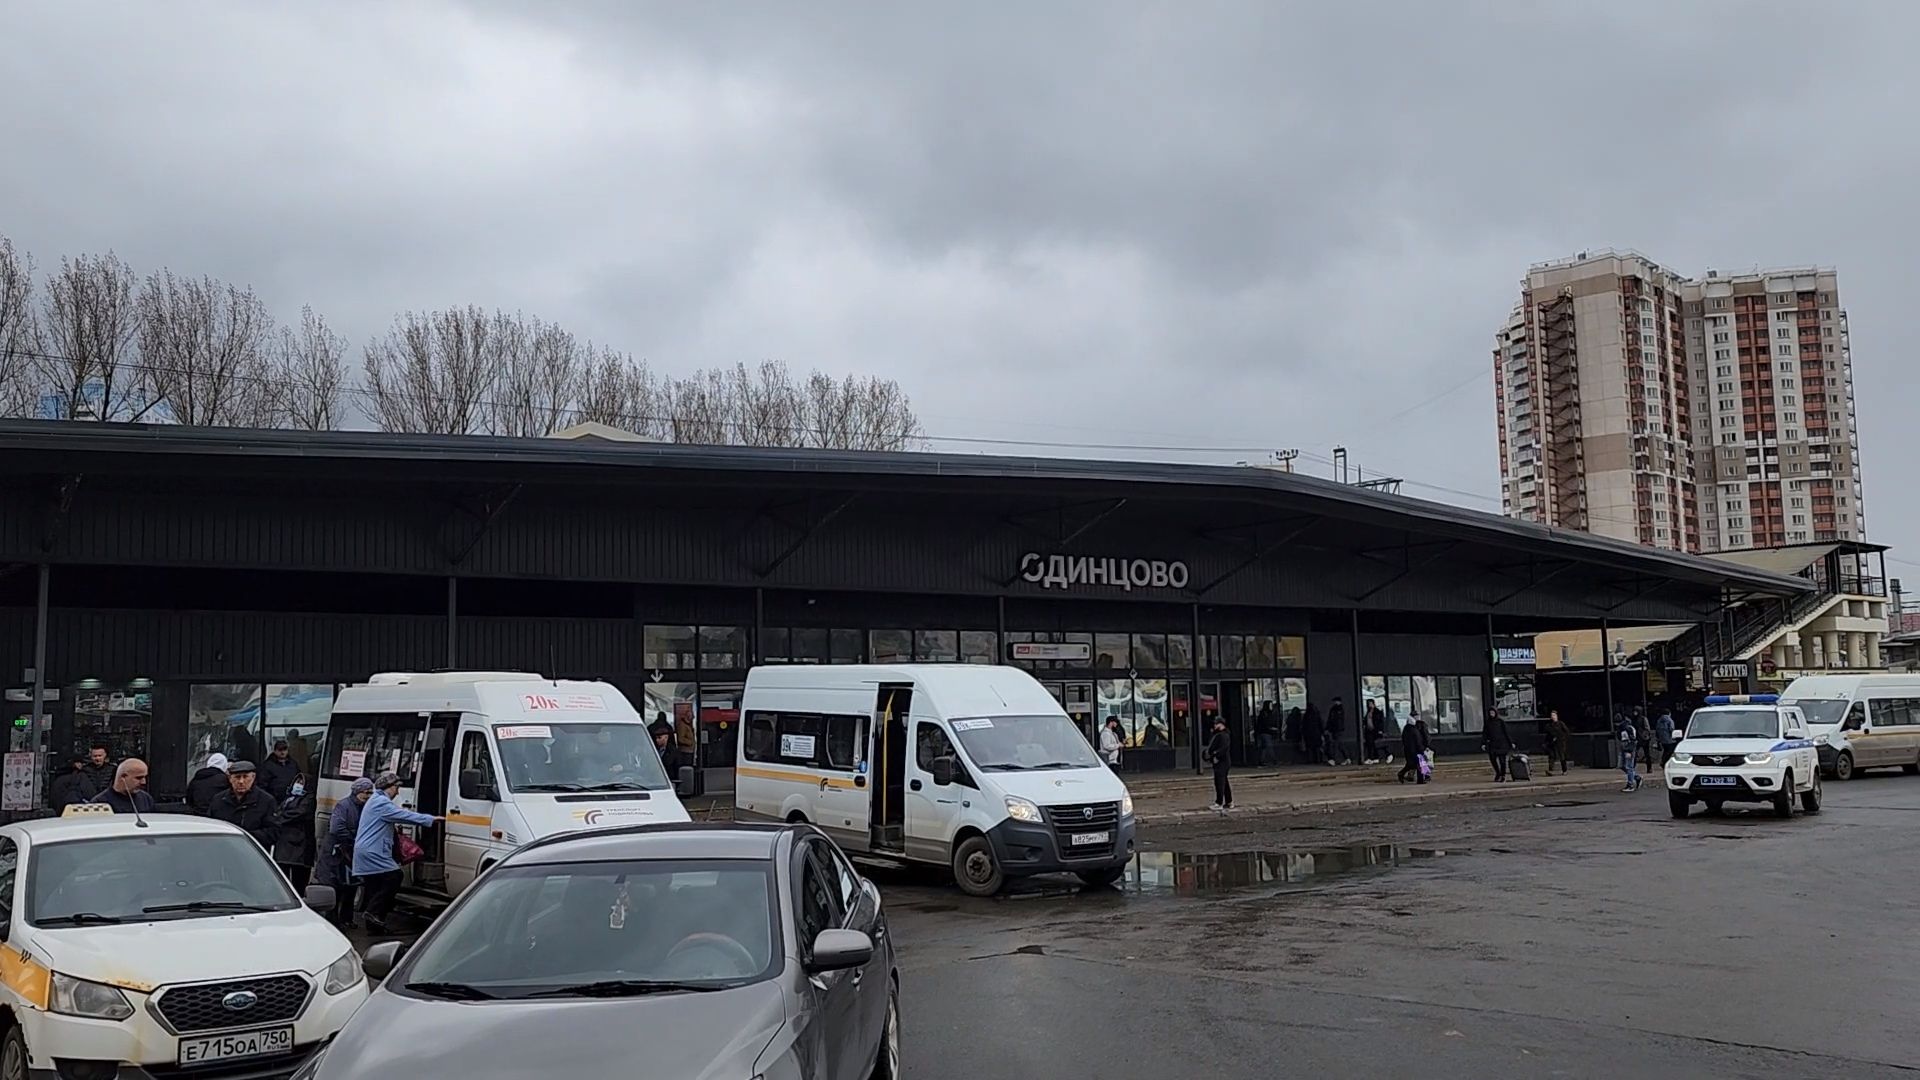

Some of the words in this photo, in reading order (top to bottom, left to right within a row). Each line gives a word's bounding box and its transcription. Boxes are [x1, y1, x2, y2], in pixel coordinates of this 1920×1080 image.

[1021, 553, 1188, 591] ОДИНЦОВО
[1499, 648, 1535, 658] ШАУРМА
[187, 1037, 257, 1060] Е715ОА
[262, 1031, 287, 1046] 750
